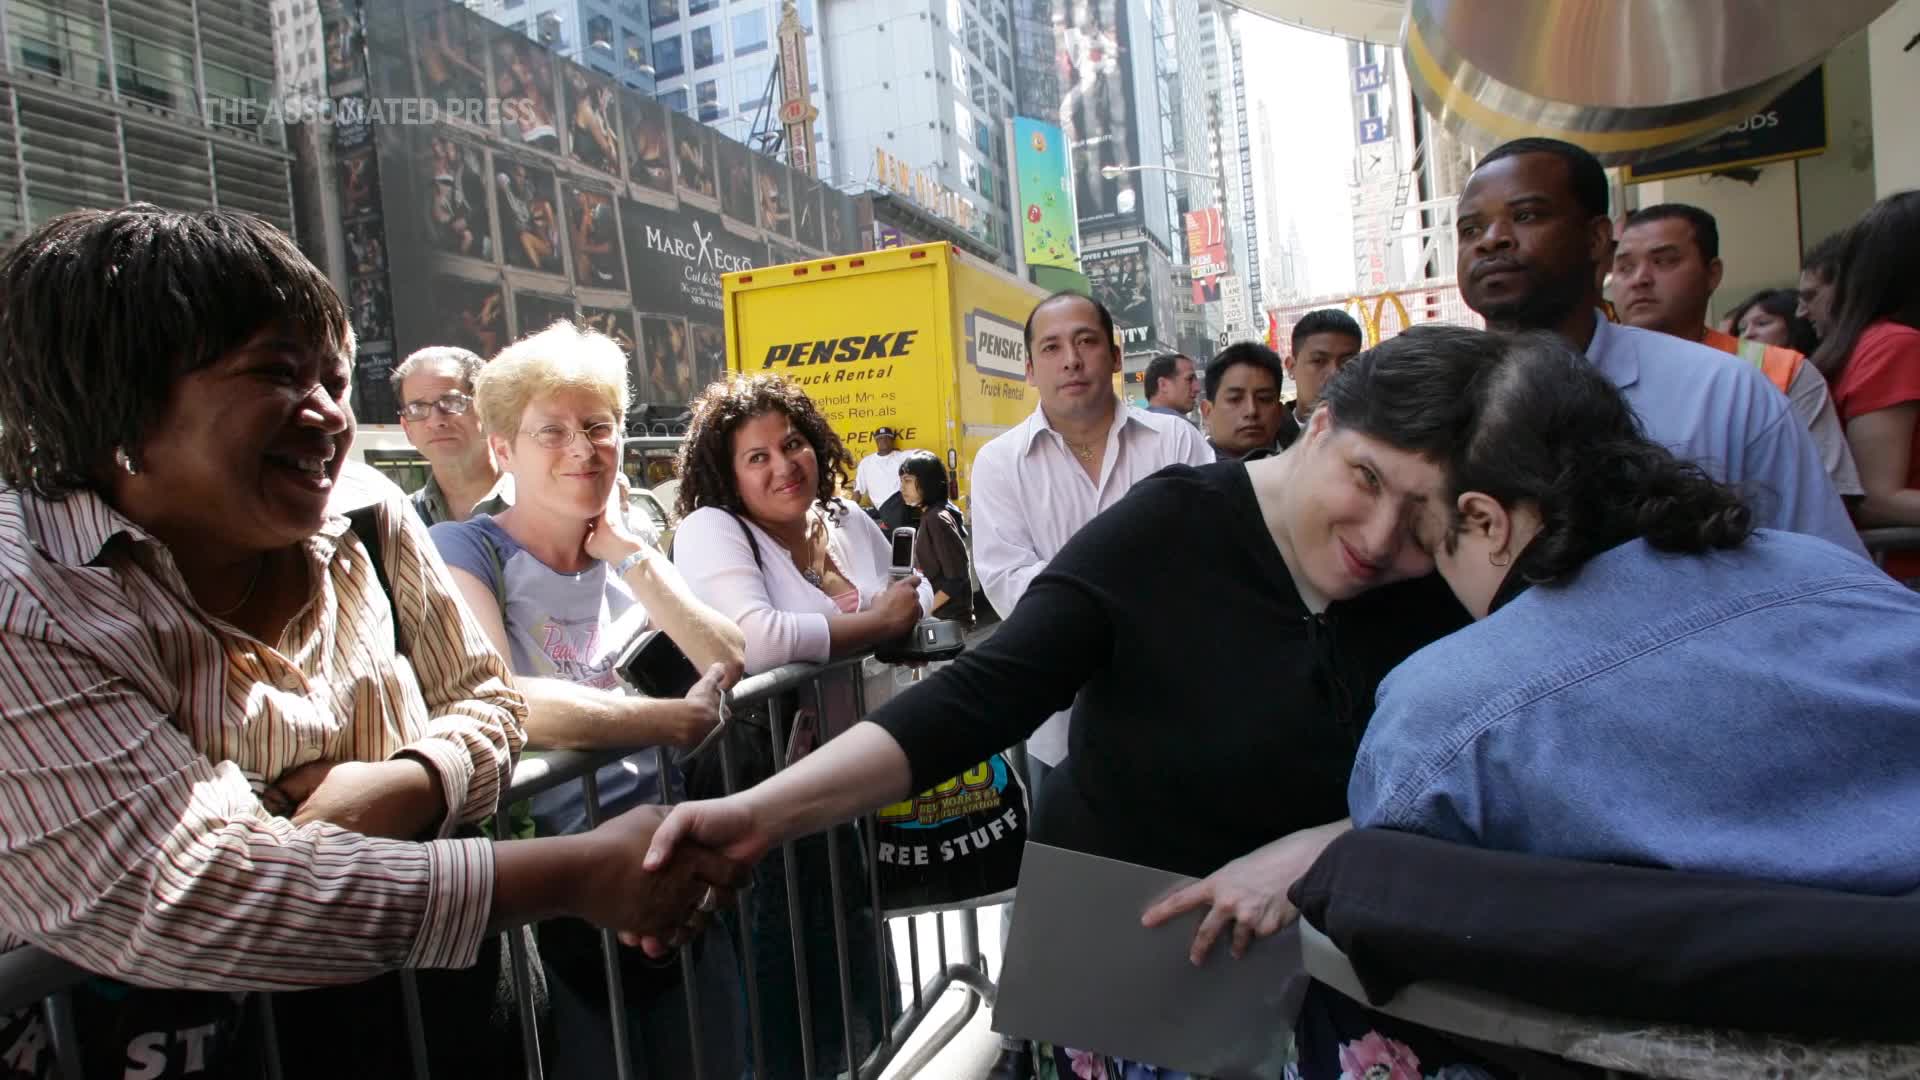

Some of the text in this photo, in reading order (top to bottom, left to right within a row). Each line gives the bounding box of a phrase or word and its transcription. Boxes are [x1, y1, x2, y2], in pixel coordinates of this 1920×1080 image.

[645, 224, 697, 261] MARC
[762, 329, 919, 370] PENSKE
[978, 331, 1023, 361] PENSKE
[835, 364, 894, 384] Rental
[980, 378, 1025, 401] Truck Rental
[877, 807, 1019, 866] REE STUFF
[123, 1021, 217, 1080] ST
